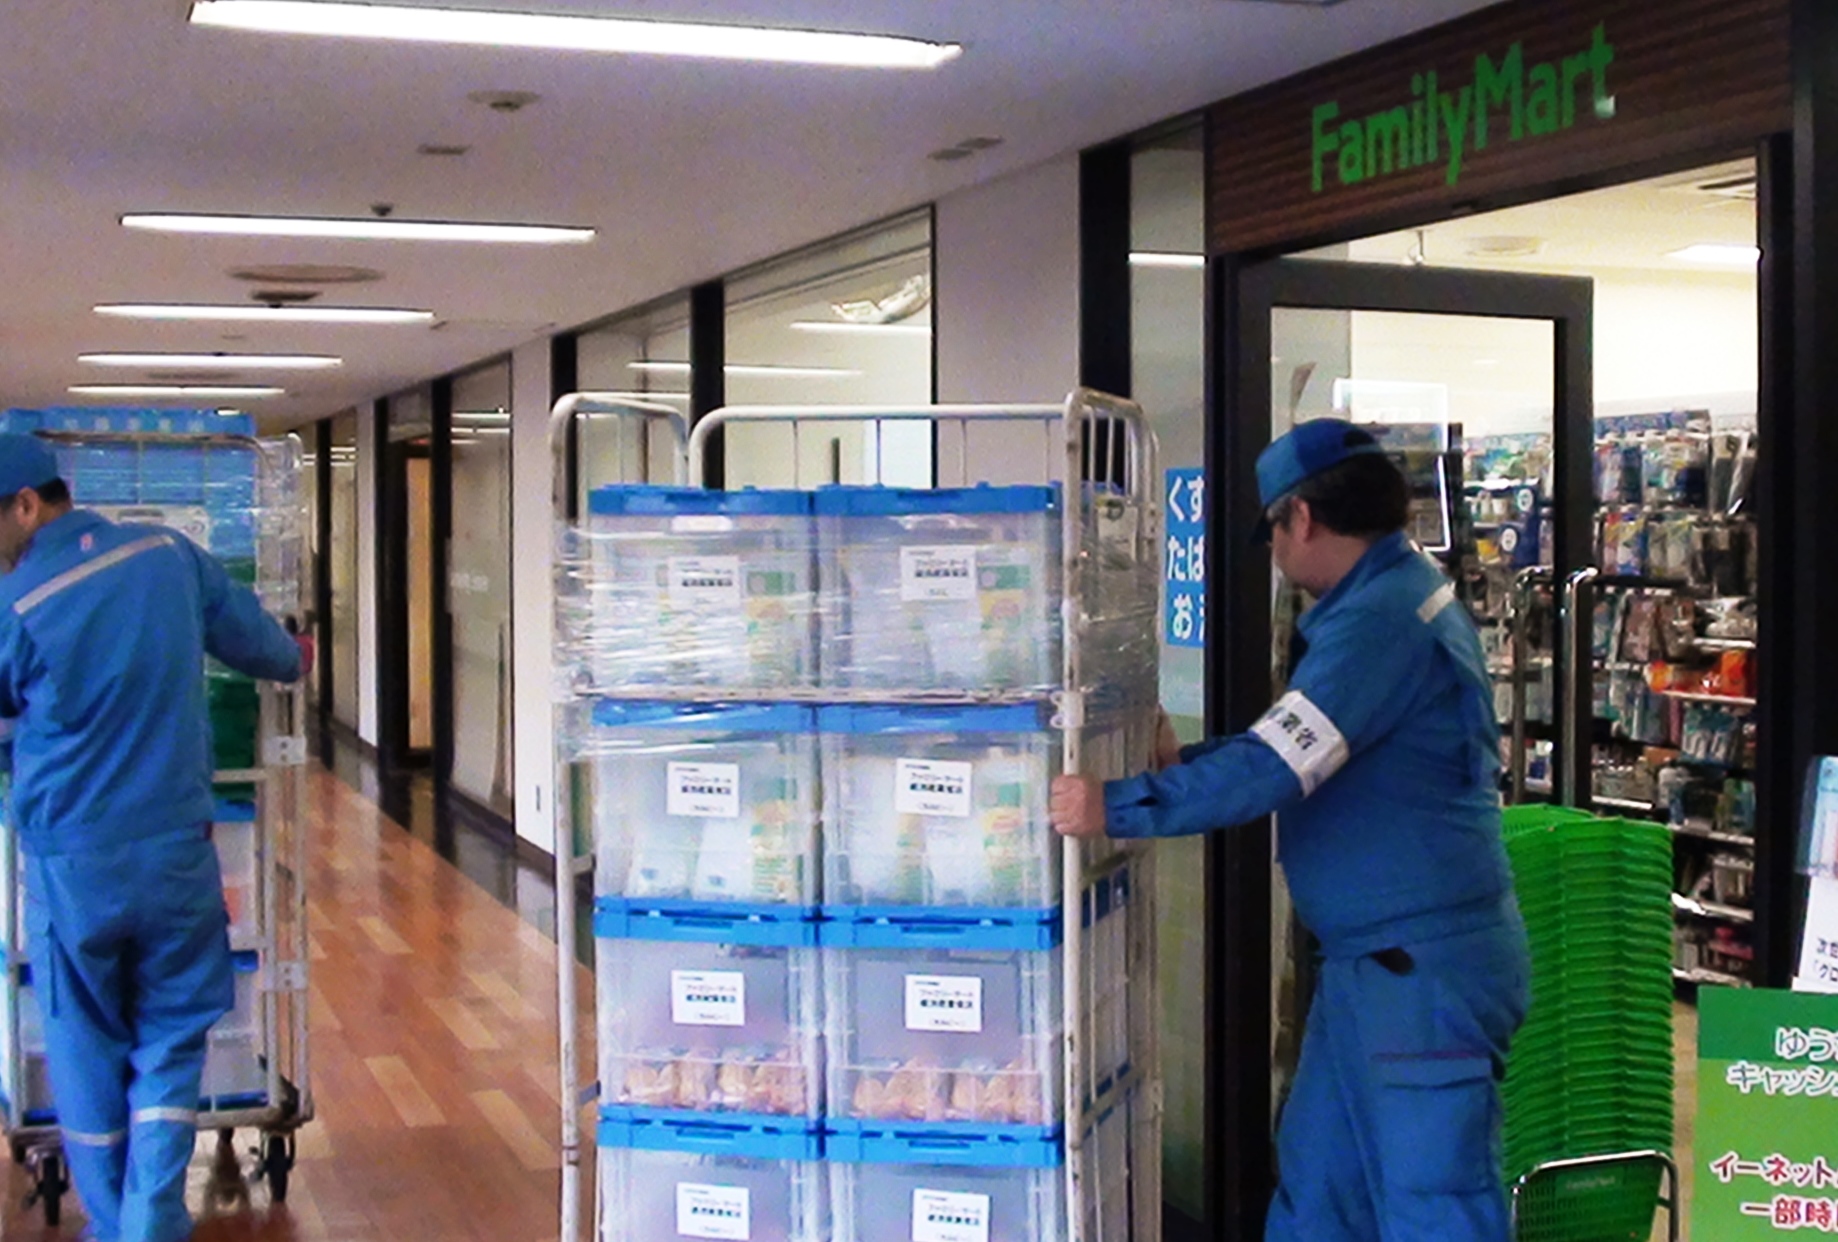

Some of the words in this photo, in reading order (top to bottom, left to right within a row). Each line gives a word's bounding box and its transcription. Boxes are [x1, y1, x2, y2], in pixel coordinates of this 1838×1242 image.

[1312, 20, 1616, 192] FamilyMart
[1173, 594, 1205, 641] お
[1776, 1027, 1838, 1061] ゆう
[1726, 1061, 1838, 1096] キャッシ
[1710, 1152, 1838, 1189] イーネット
[1740, 1198, 1838, 1231] 一部時
